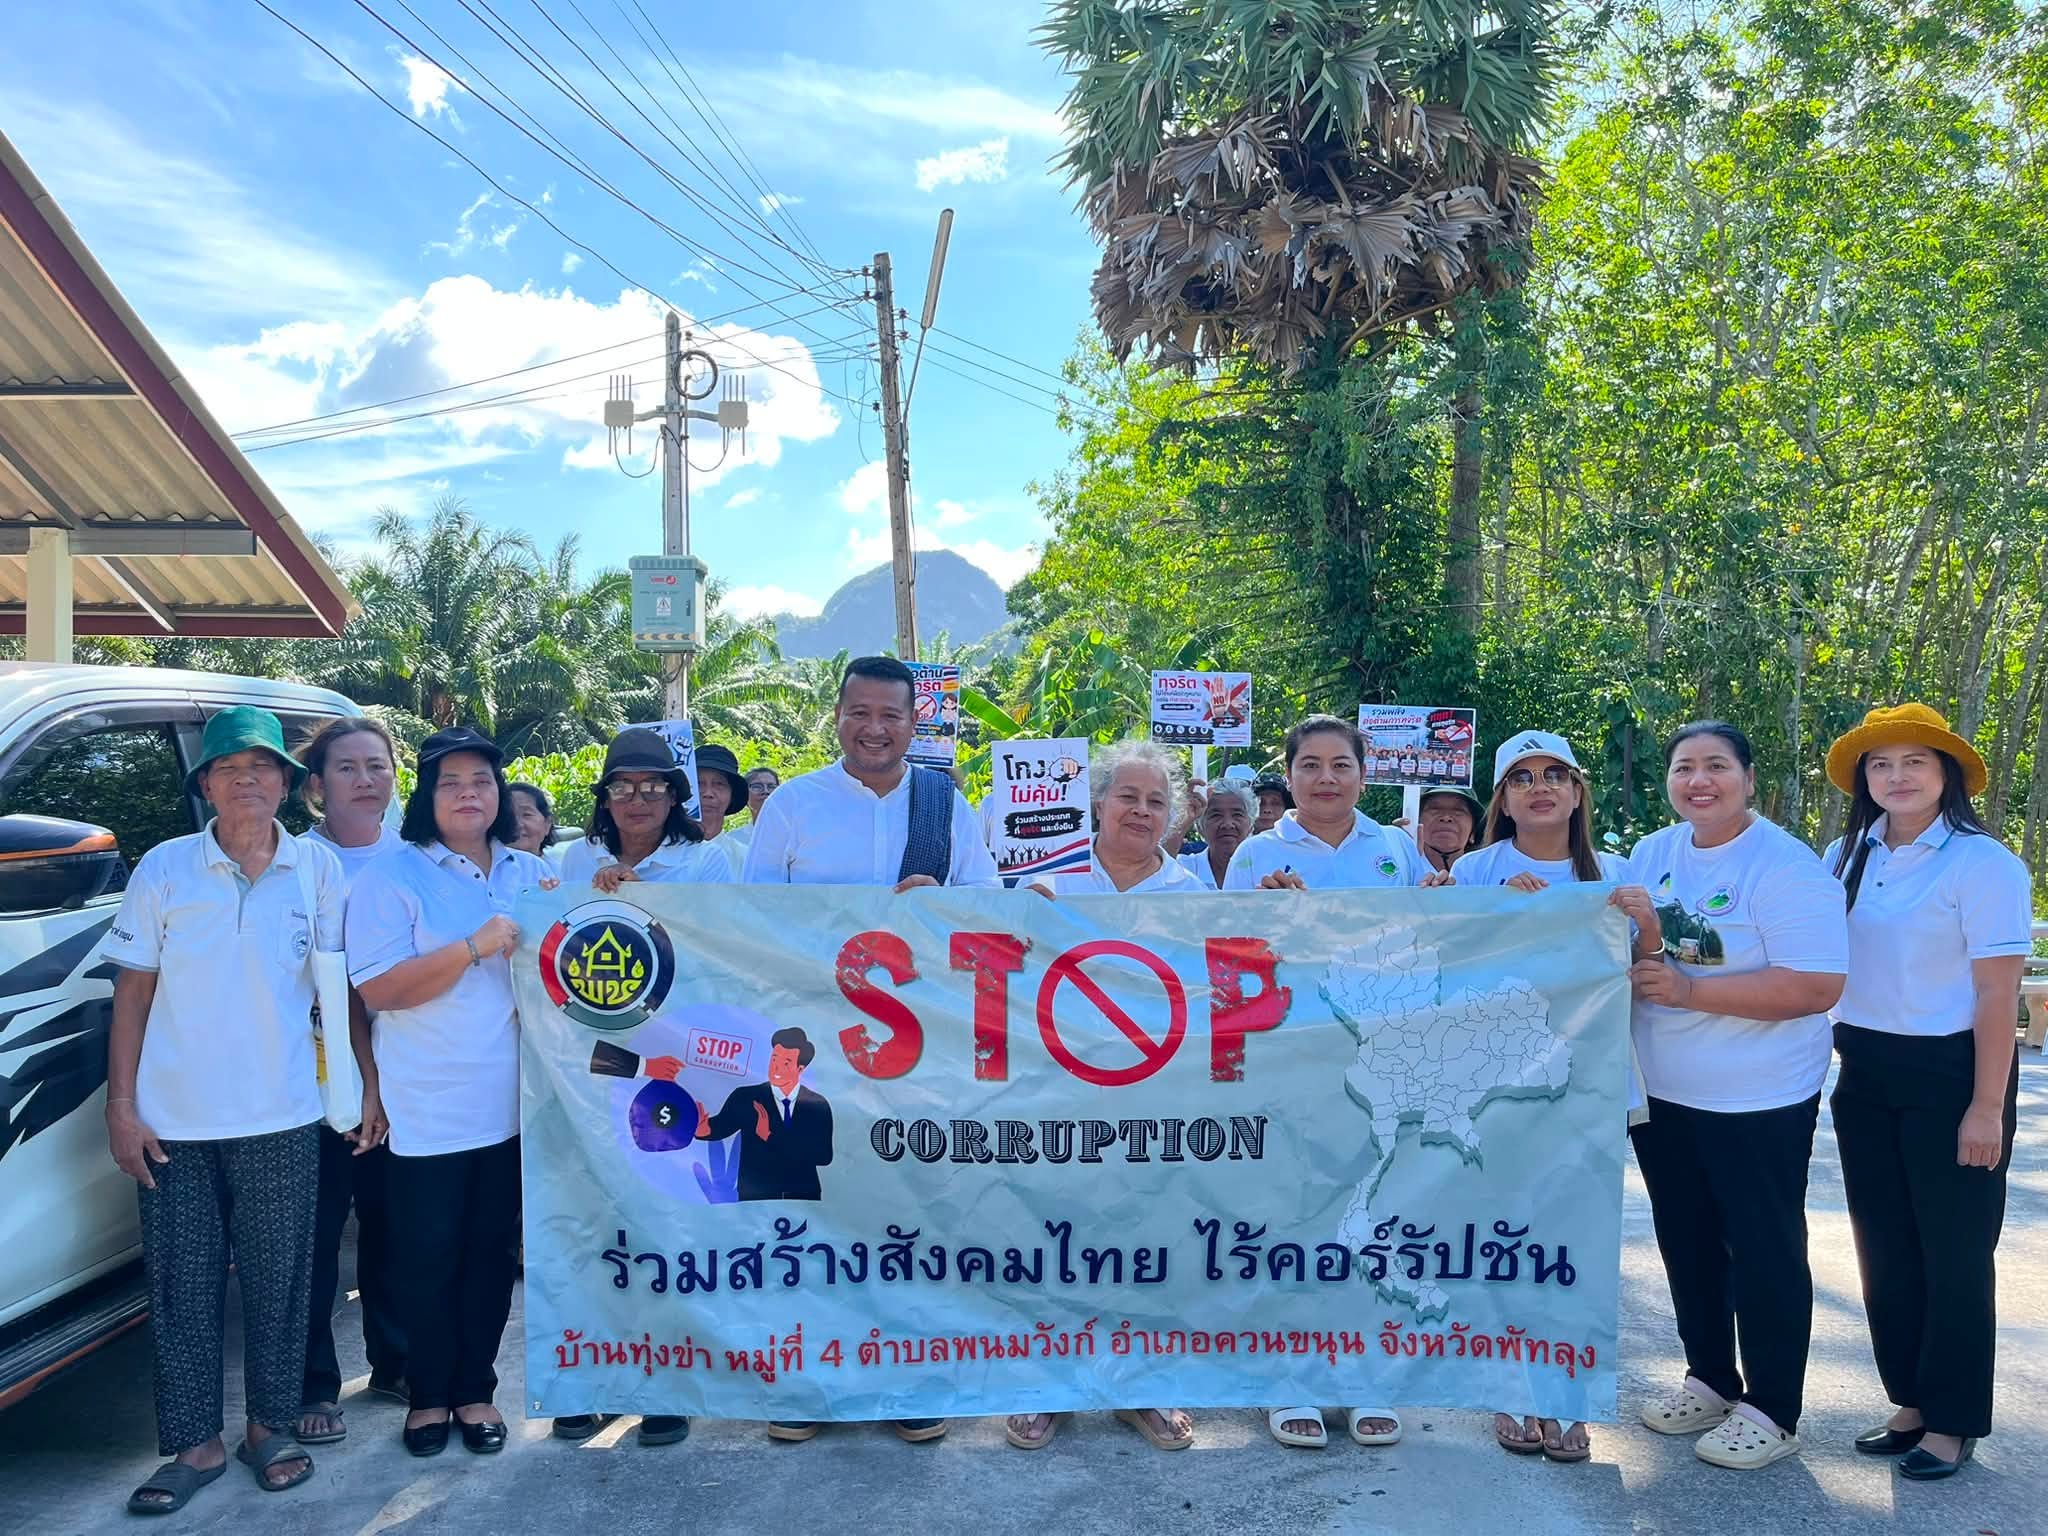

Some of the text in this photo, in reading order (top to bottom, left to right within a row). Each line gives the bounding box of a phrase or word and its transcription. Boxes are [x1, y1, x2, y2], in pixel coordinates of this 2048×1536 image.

[1213, 695, 1225, 704] NO
[1002, 753, 1046, 781] โกง
[1010, 783, 1068, 808] ไม่คุ้ม!
[696, 1036, 743, 1060] STOP
[870, 1114, 1268, 1165] CORRUPTION
[600, 1215, 1577, 1294] ร่วมสร้างสังคมไทย ไร้คอร์รัปชัน
[555, 1317, 1597, 1384] บ้านทุ่งข่า หมู่ที่ 4 ตำบลพนมวังก์ อำเภอควนขนุน จังหวัดพัทลุง
